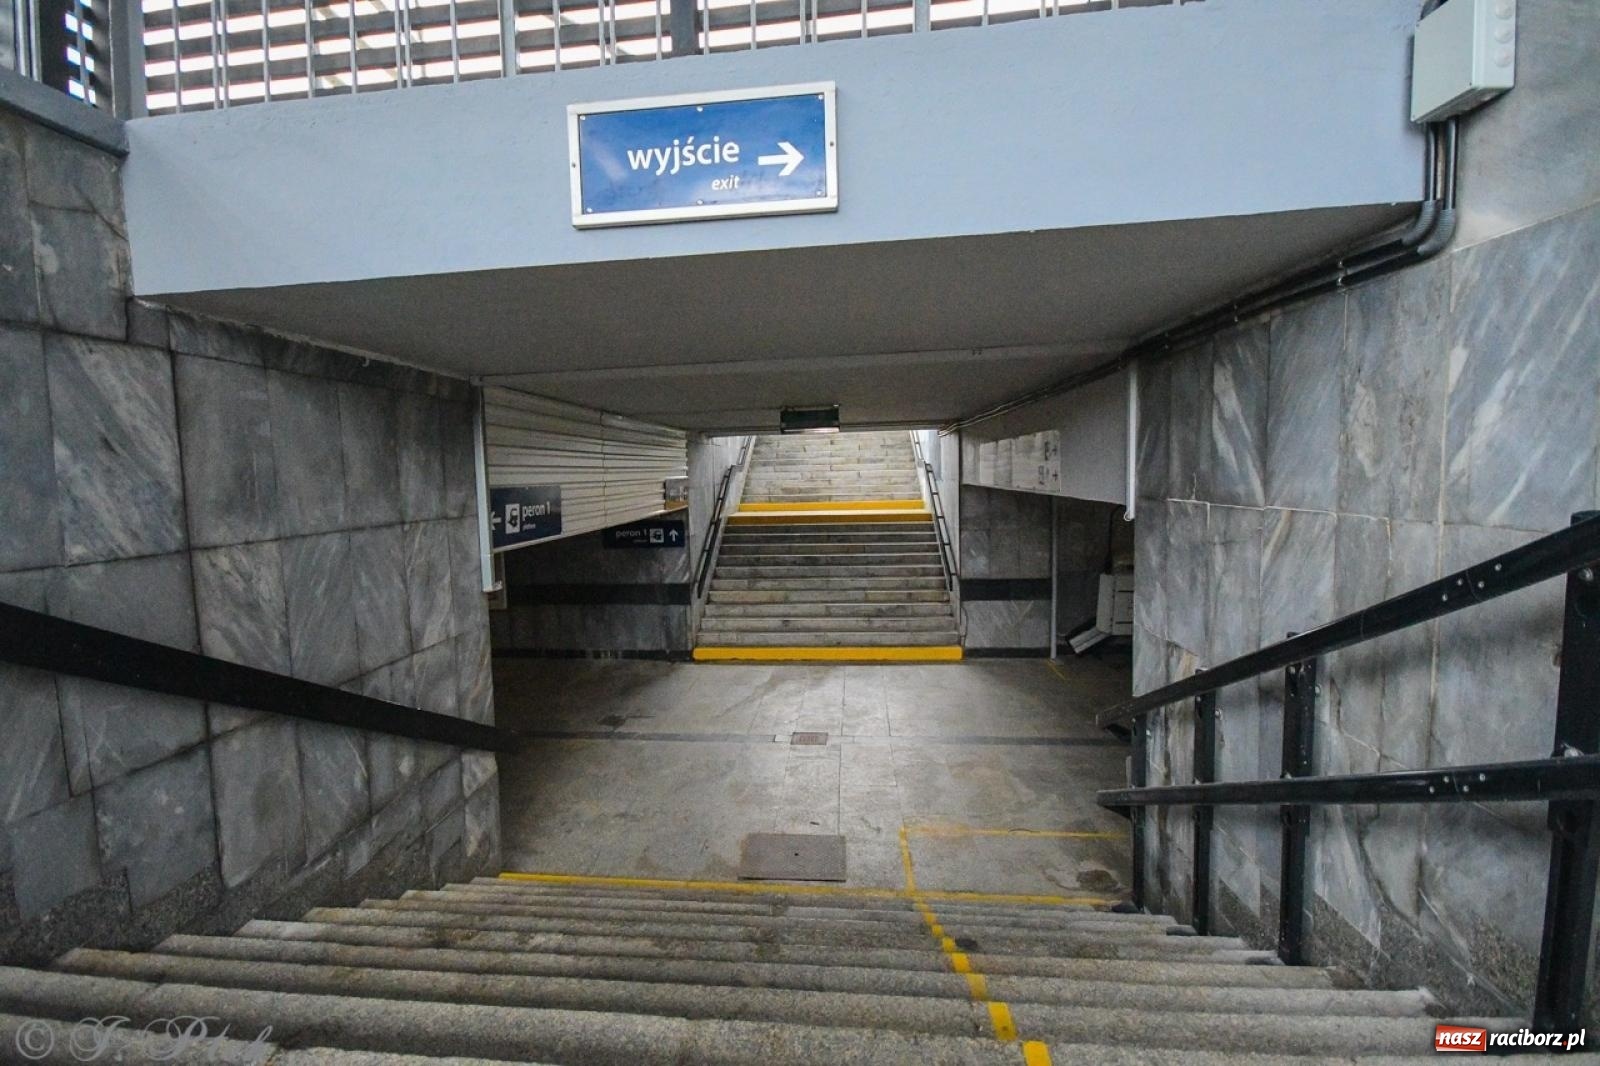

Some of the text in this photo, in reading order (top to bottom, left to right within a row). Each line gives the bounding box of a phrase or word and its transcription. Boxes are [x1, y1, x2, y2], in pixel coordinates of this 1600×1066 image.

[627, 136, 740, 176] wyjście
[711, 175, 740, 191] exit
[522, 504, 546, 521] peron
